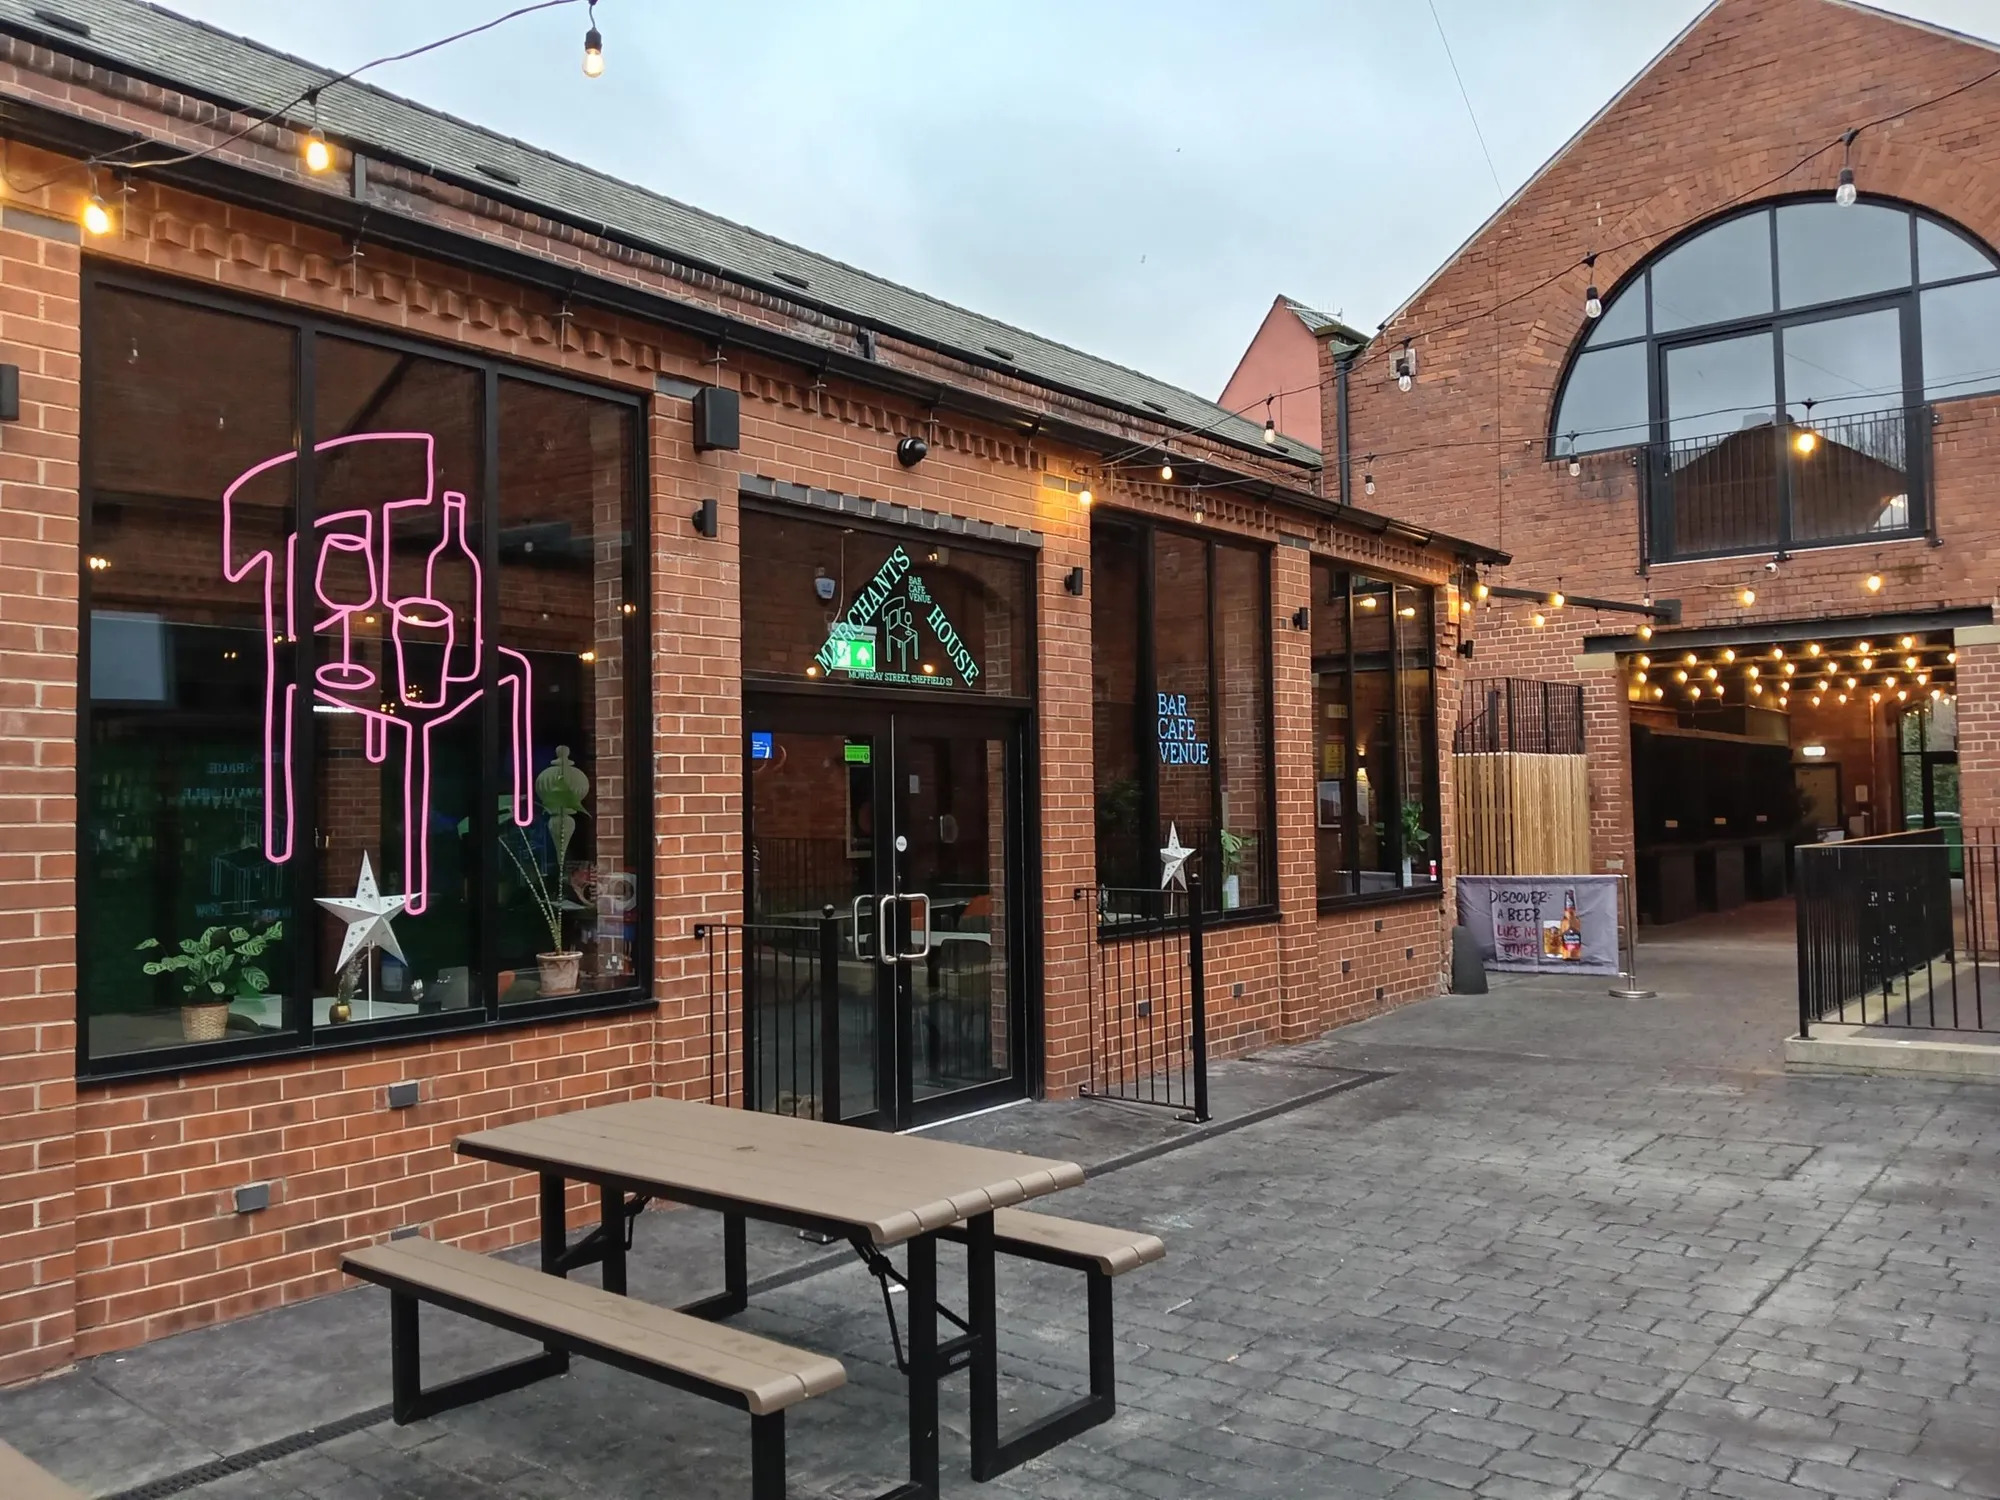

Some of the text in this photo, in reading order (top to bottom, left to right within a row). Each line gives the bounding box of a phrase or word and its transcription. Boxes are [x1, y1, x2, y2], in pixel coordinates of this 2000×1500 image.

[908, 575, 922, 585] BAR
[908, 585, 926, 595] CAFE
[909, 592, 931, 604] VENUE
[926, 604, 980, 687] HOUSE
[848, 669, 884, 681] MOWBRAY
[911, 675, 945, 686] SHEFFIELD
[1157, 693, 1187, 716] BAR
[1157, 718, 1196, 740] CAFE
[1158, 742, 1209, 764] VENUE
[1497, 908, 1541, 921] A BEER
[1497, 924, 1538, 938] LIKE NO
[1504, 943, 1539, 957] OTHER
